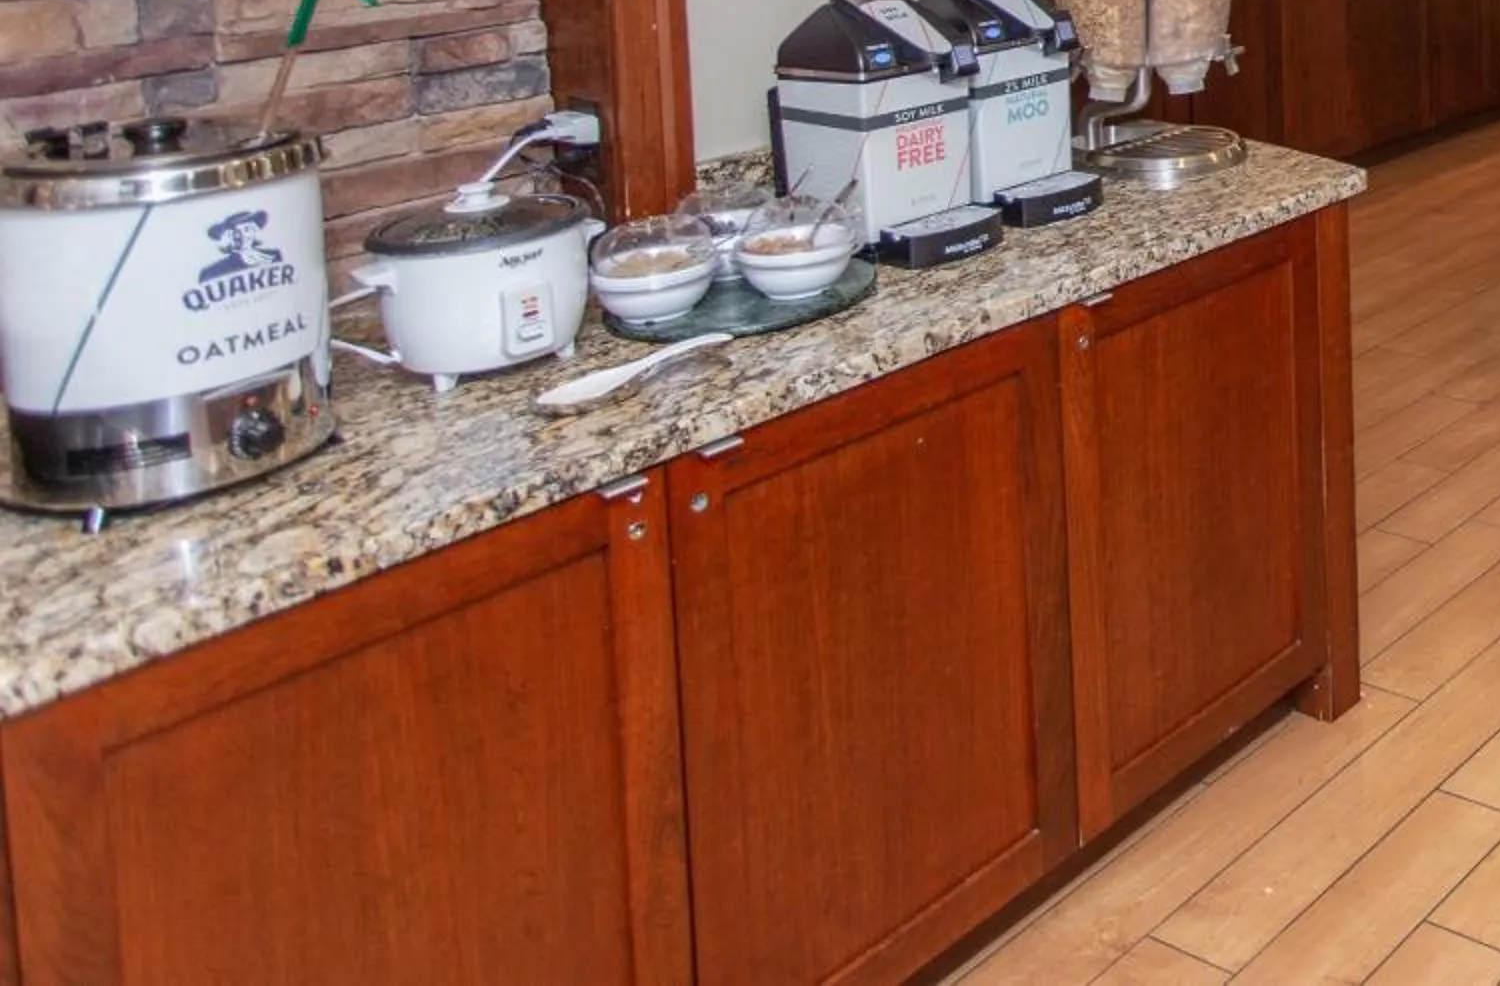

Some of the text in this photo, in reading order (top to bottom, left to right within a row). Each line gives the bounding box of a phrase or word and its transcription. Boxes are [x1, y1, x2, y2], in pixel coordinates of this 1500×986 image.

[1021, 74, 1049, 89] MILK
[894, 103, 945, 123] SOY MILK
[1006, 99, 1050, 126] MOO
[896, 126, 945, 151] DAIRY
[897, 141, 946, 171] FREE
[182, 263, 296, 312] QUAKER
[176, 313, 308, 365] OATMEAL
